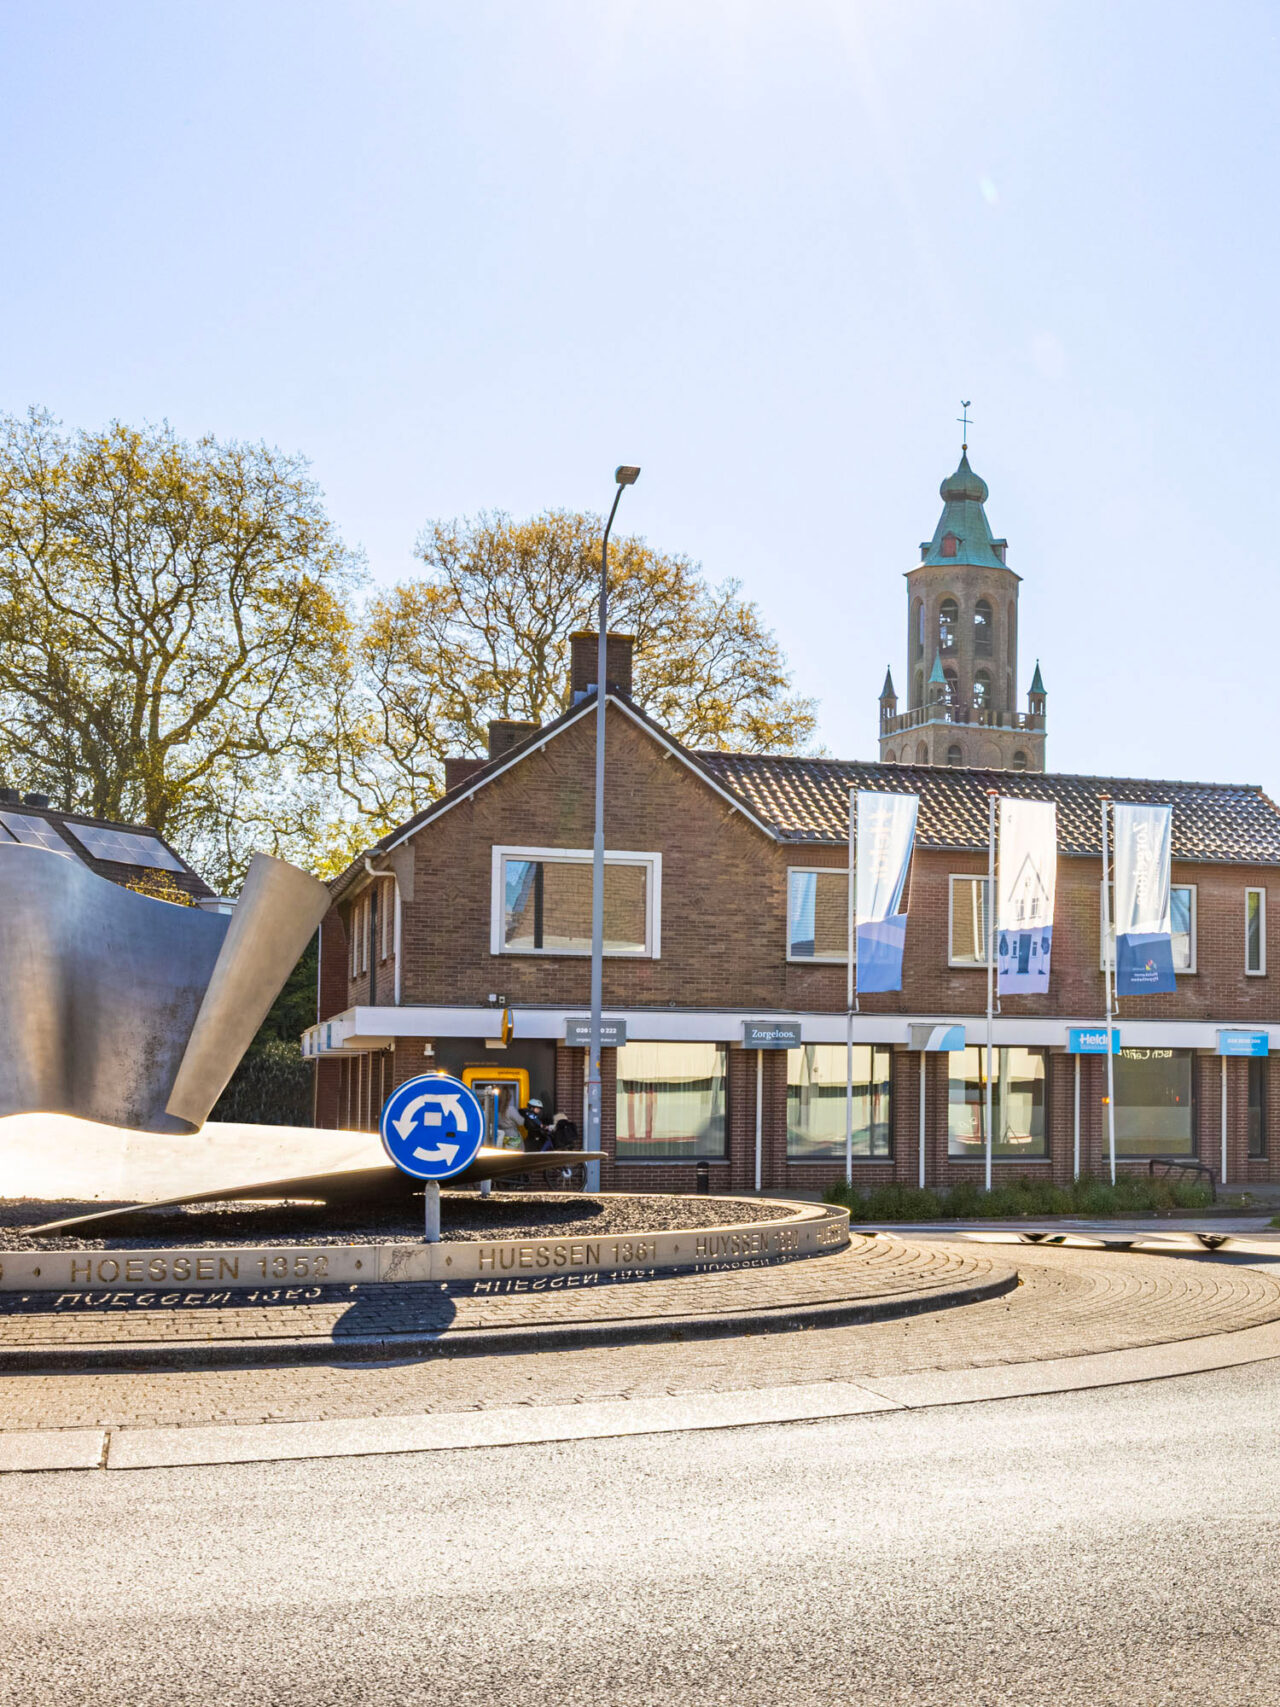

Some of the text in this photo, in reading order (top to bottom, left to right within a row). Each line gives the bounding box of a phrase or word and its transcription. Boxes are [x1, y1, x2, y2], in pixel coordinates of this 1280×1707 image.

[752, 1029, 796, 1040] Zorgeloos.
[478, 1241, 657, 1271] HUESSEN 1361
[695, 1232, 769, 1258] HUYSSEN
[70, 1255, 330, 1284] HOESSEN 1352
